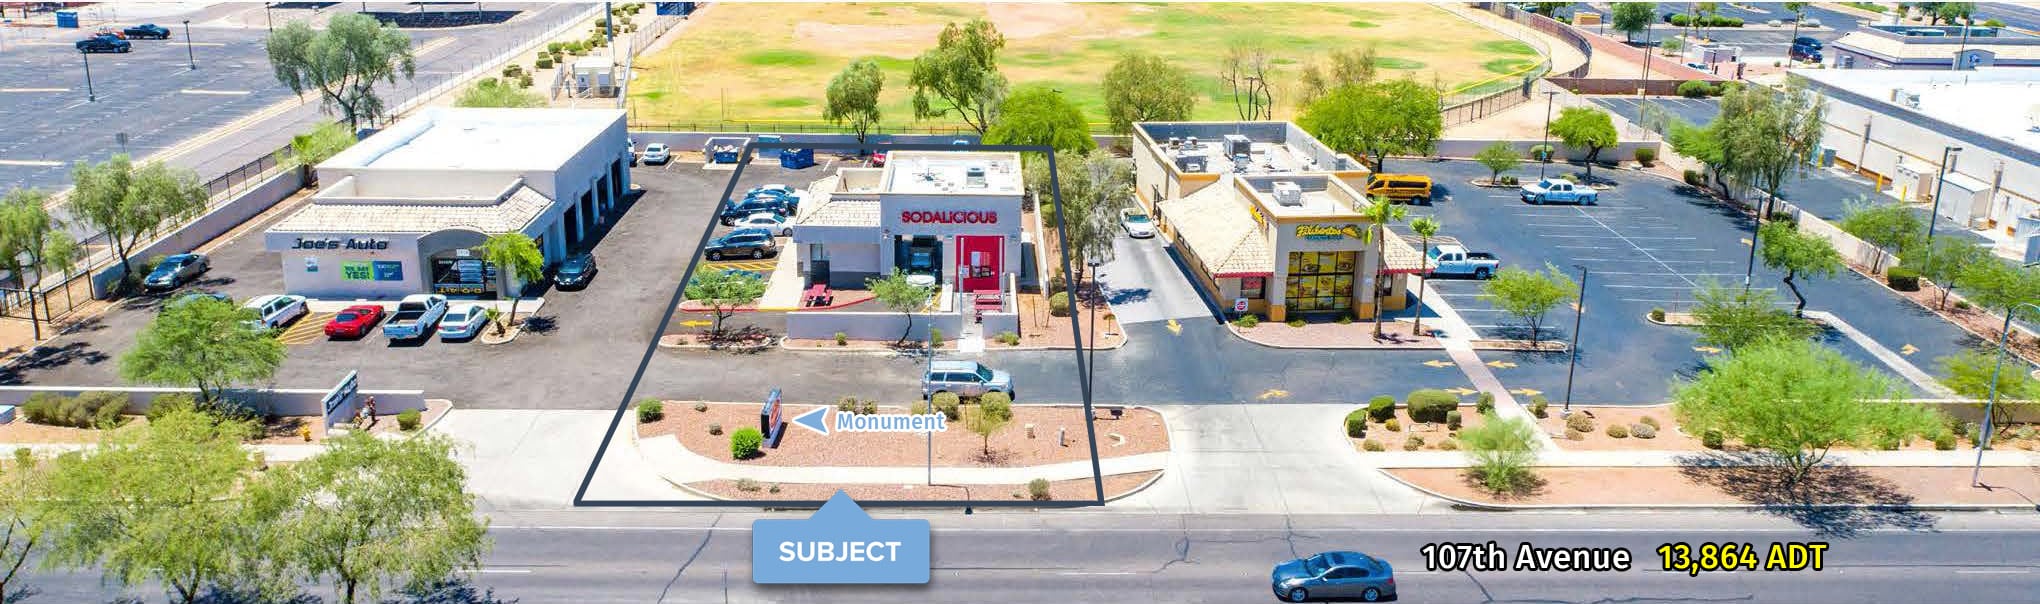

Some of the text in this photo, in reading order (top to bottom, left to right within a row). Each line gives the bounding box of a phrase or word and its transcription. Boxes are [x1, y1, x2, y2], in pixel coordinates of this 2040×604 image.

[901, 210, 998, 224] SODALICIOUS
[292, 237, 389, 250] Joe's Auto
